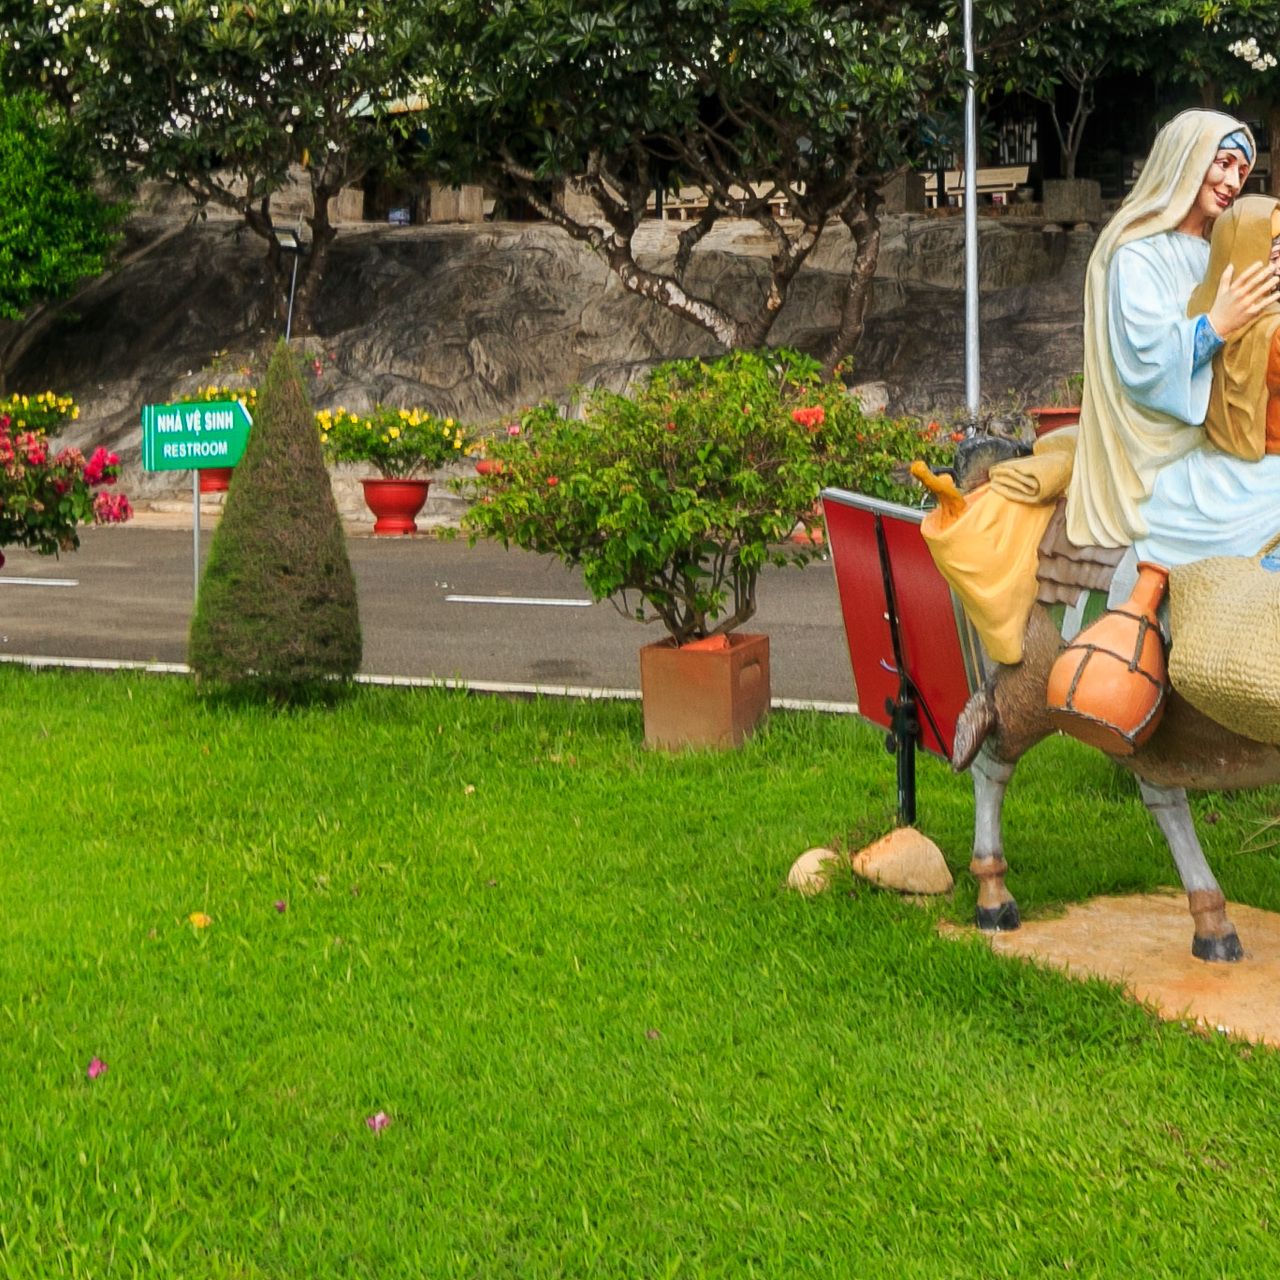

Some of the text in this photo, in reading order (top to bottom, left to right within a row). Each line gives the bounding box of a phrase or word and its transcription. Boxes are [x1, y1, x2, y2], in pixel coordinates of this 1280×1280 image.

[157, 407, 234, 437] NHÀ VỆ SINH
[163, 441, 228, 458] RESTROOM
